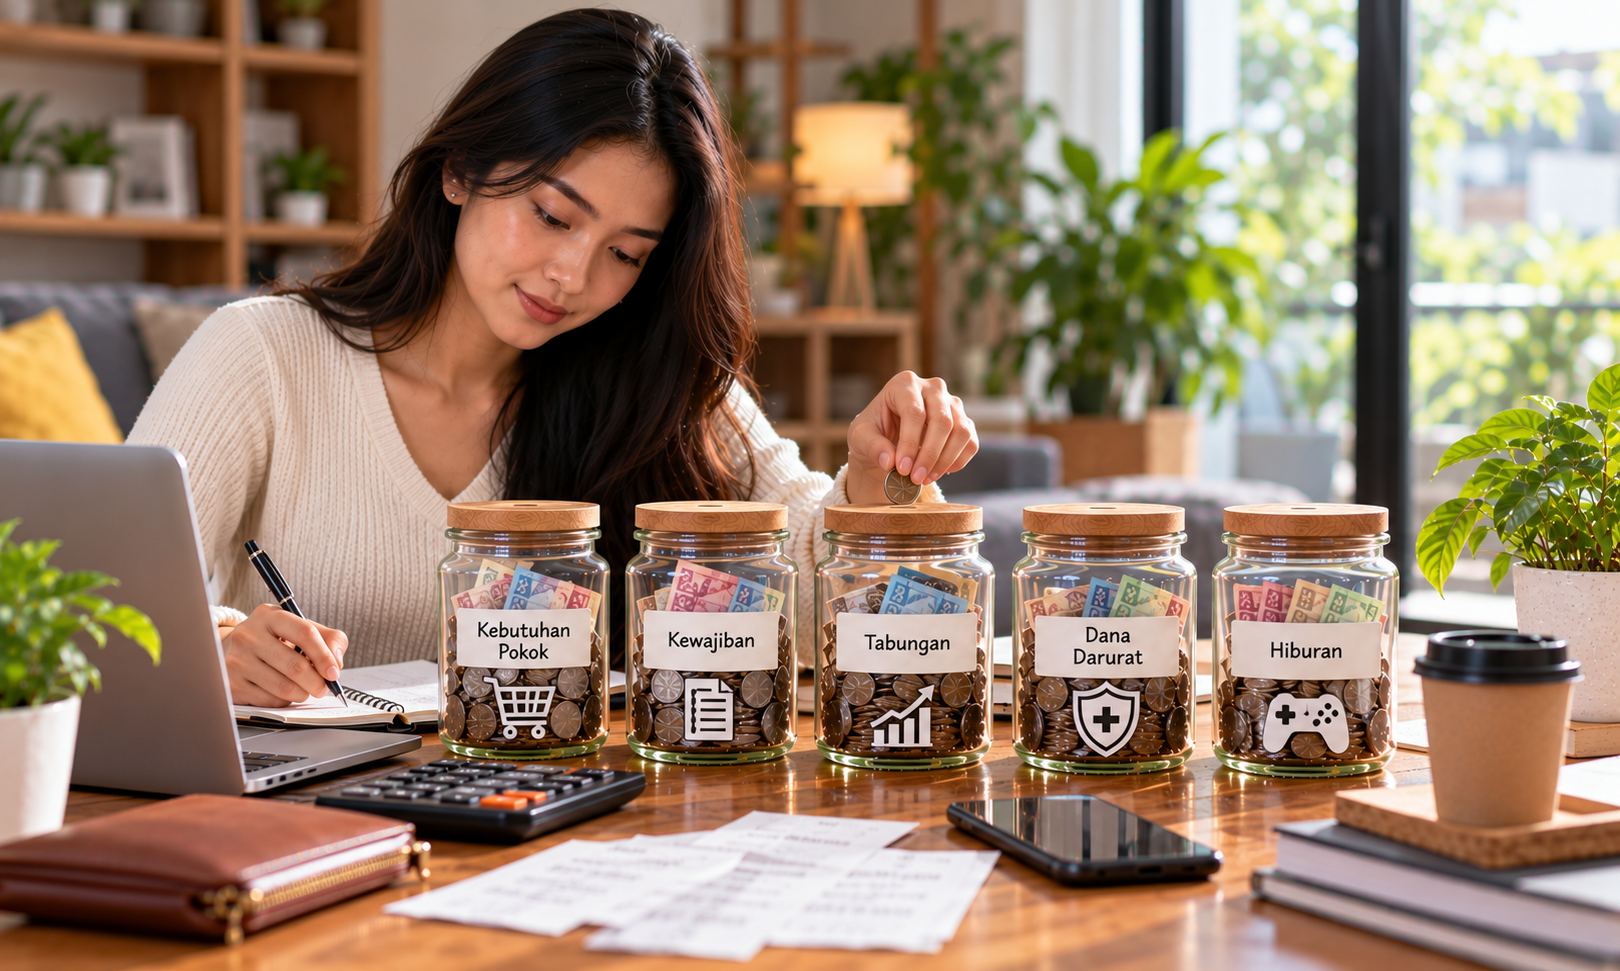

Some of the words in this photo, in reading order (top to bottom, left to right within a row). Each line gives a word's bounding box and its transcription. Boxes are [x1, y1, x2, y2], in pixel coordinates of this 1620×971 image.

[477, 621, 570, 638] Kebutuhan
[1085, 626, 1131, 643] Dana
[498, 642, 549, 660] Pokok
[668, 632, 755, 653] Kewajiban
[864, 633, 950, 656] Tabungan
[1270, 641, 1342, 659] Hiburan
[1073, 648, 1144, 666] Darurat
